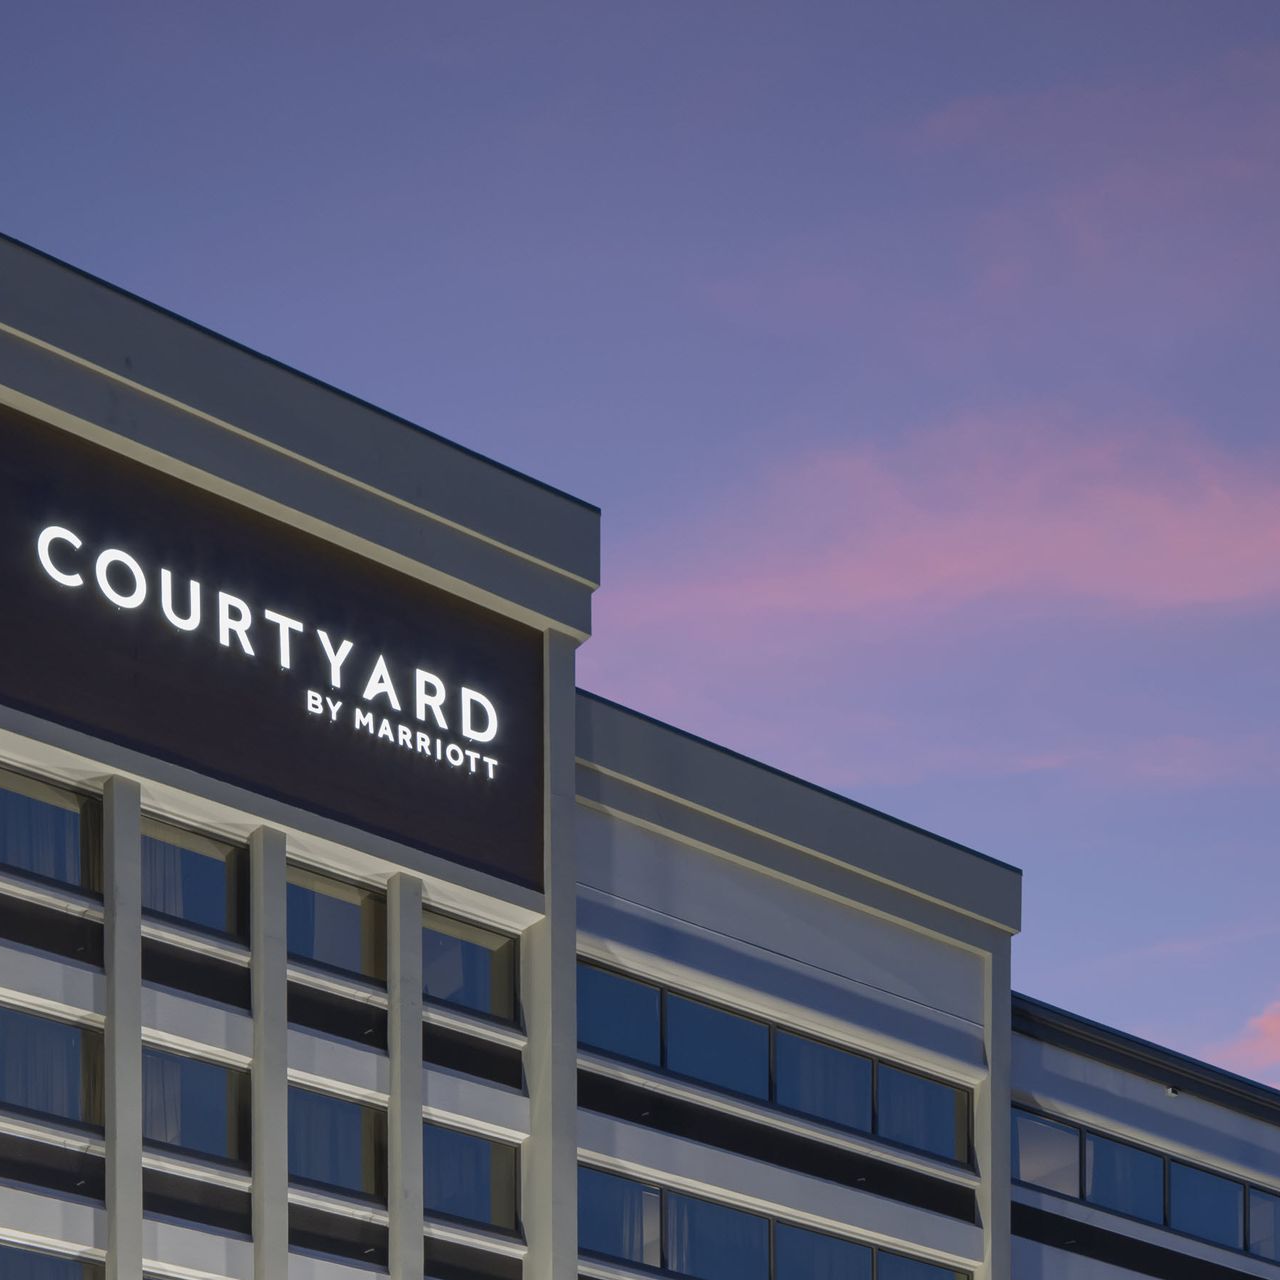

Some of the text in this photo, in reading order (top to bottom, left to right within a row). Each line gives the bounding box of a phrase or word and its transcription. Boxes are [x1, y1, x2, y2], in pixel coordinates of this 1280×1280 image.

[37, 525, 499, 743] COURTYARD
[307, 689, 499, 780] BY MARRIOTT
